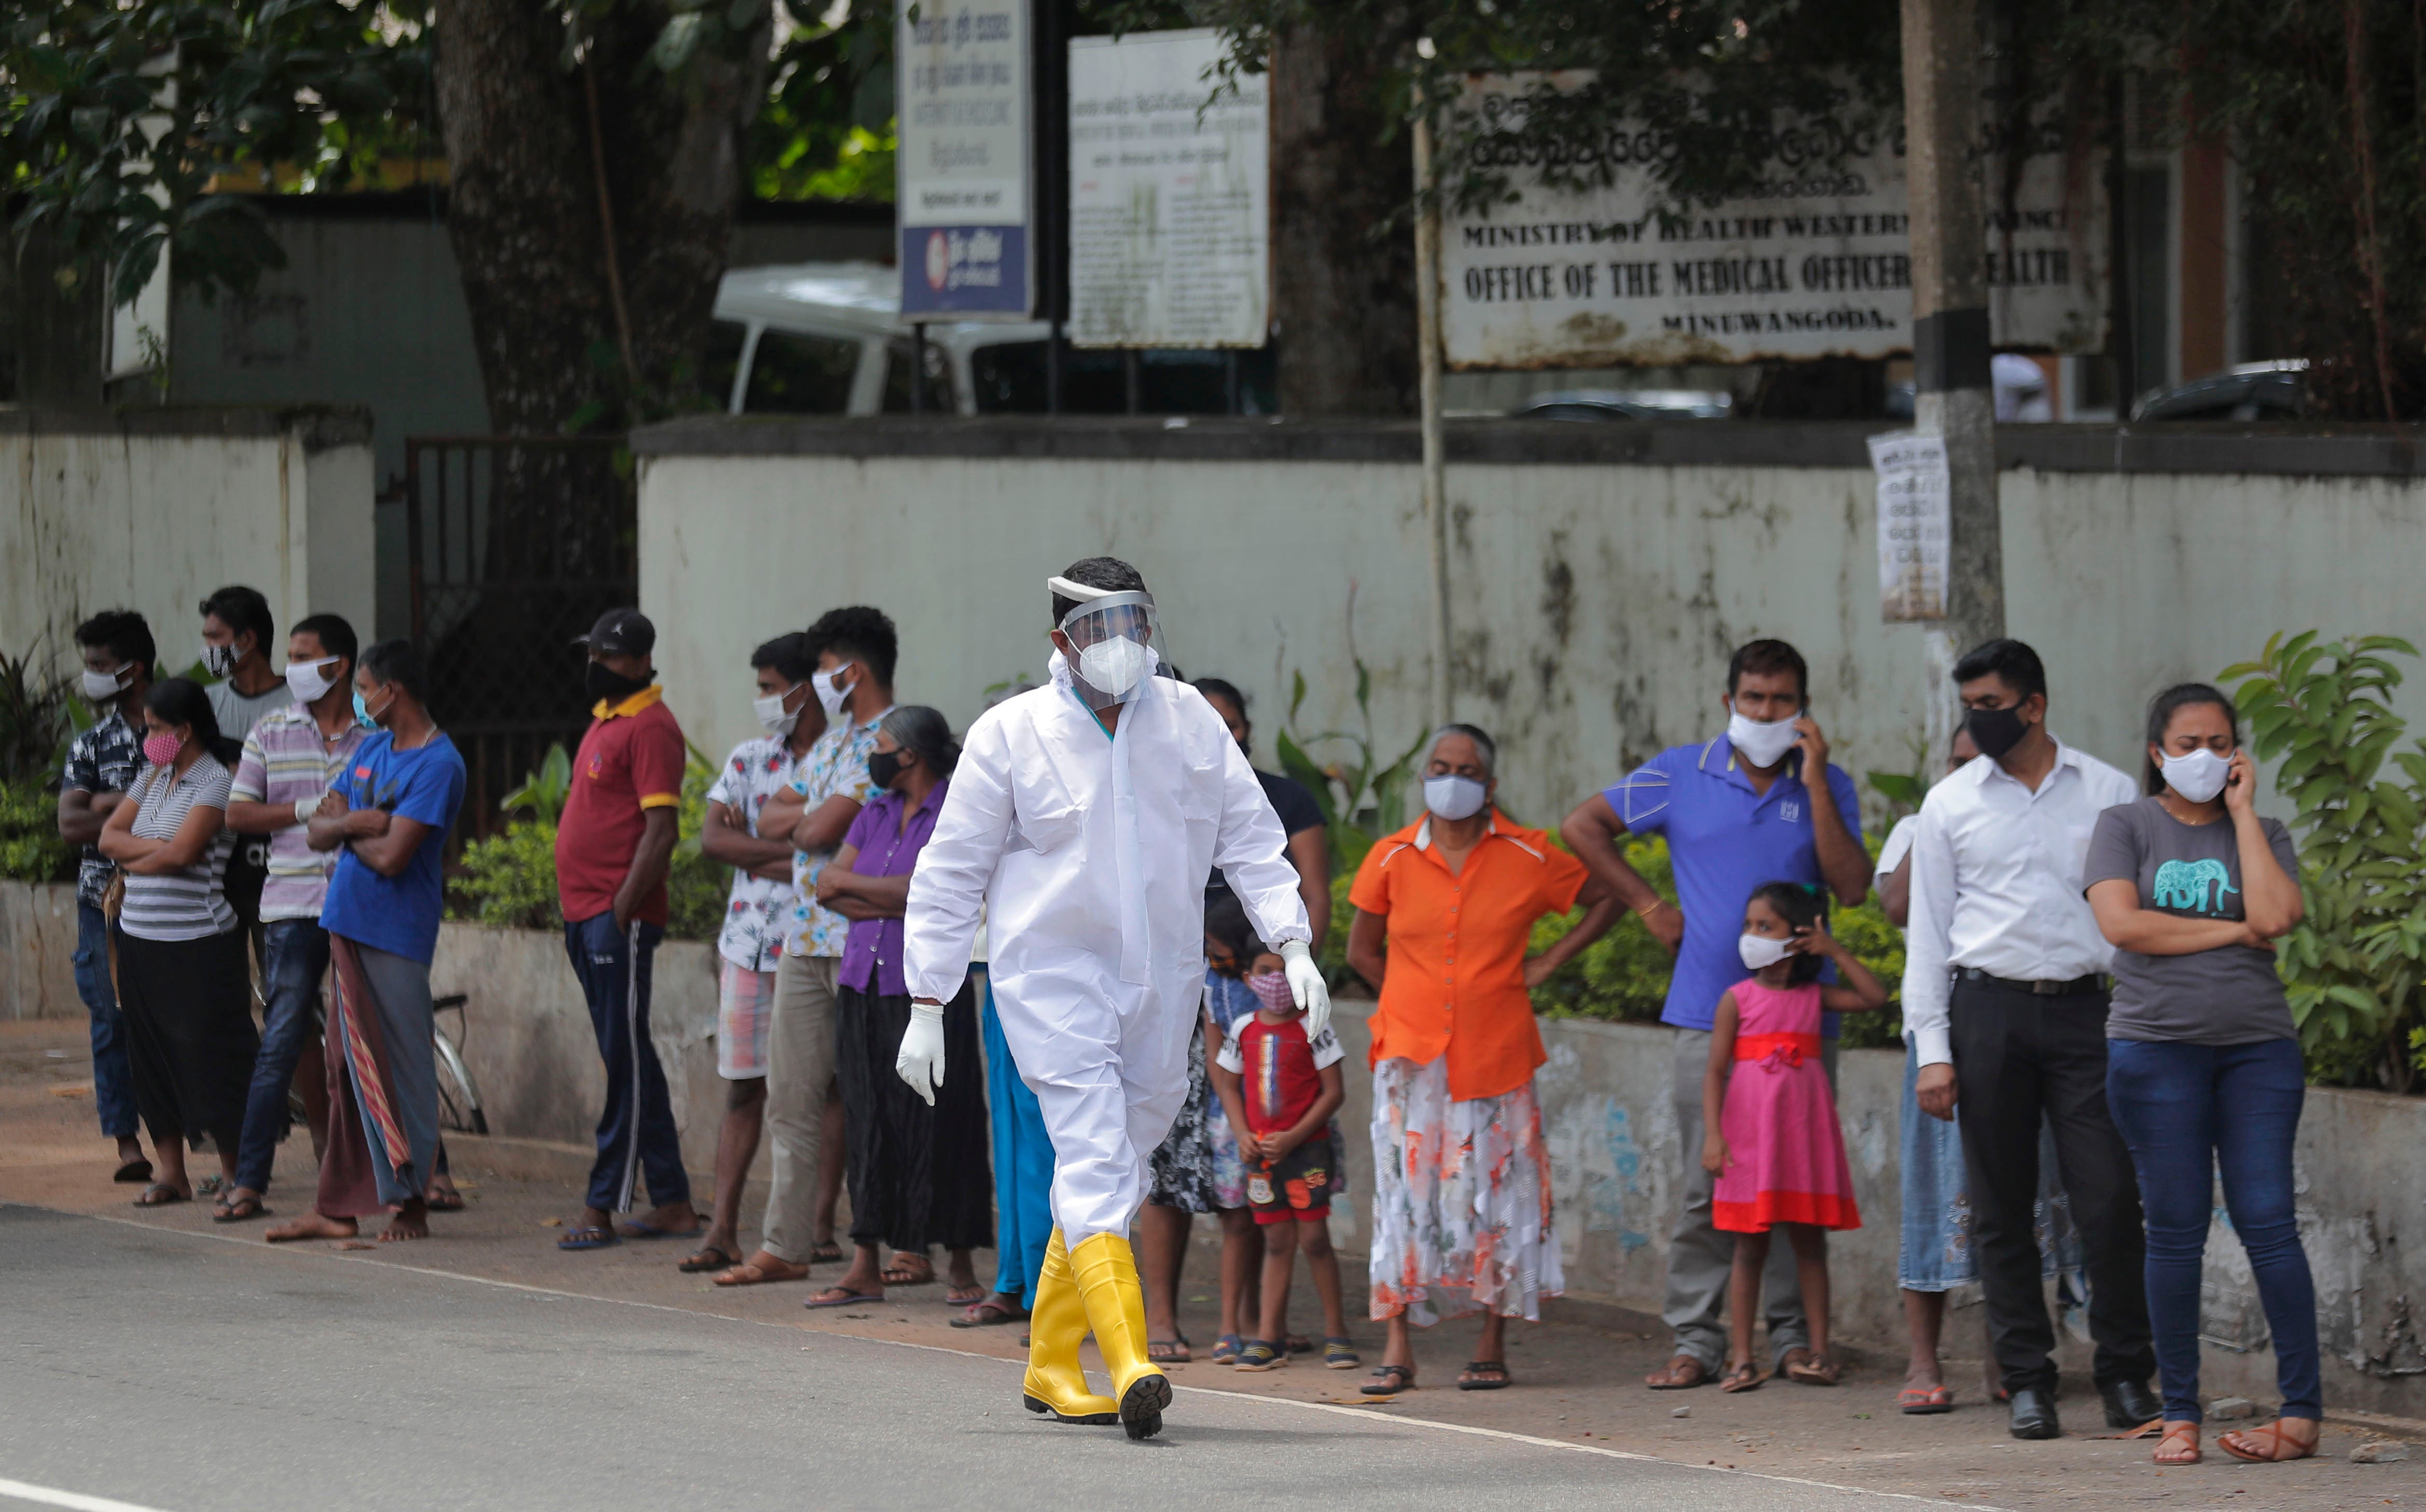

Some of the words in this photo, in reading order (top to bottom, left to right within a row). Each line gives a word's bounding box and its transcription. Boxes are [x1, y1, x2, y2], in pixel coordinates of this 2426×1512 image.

[1463, 223, 1599, 246] MINISTRY
[1464, 265, 1555, 303] OFFICE
[1563, 262, 1598, 299] OF
[1609, 261, 1662, 298] THE
[1672, 256, 1790, 296] MEDICAL
[1801, 254, 1912, 293] OFFICER
